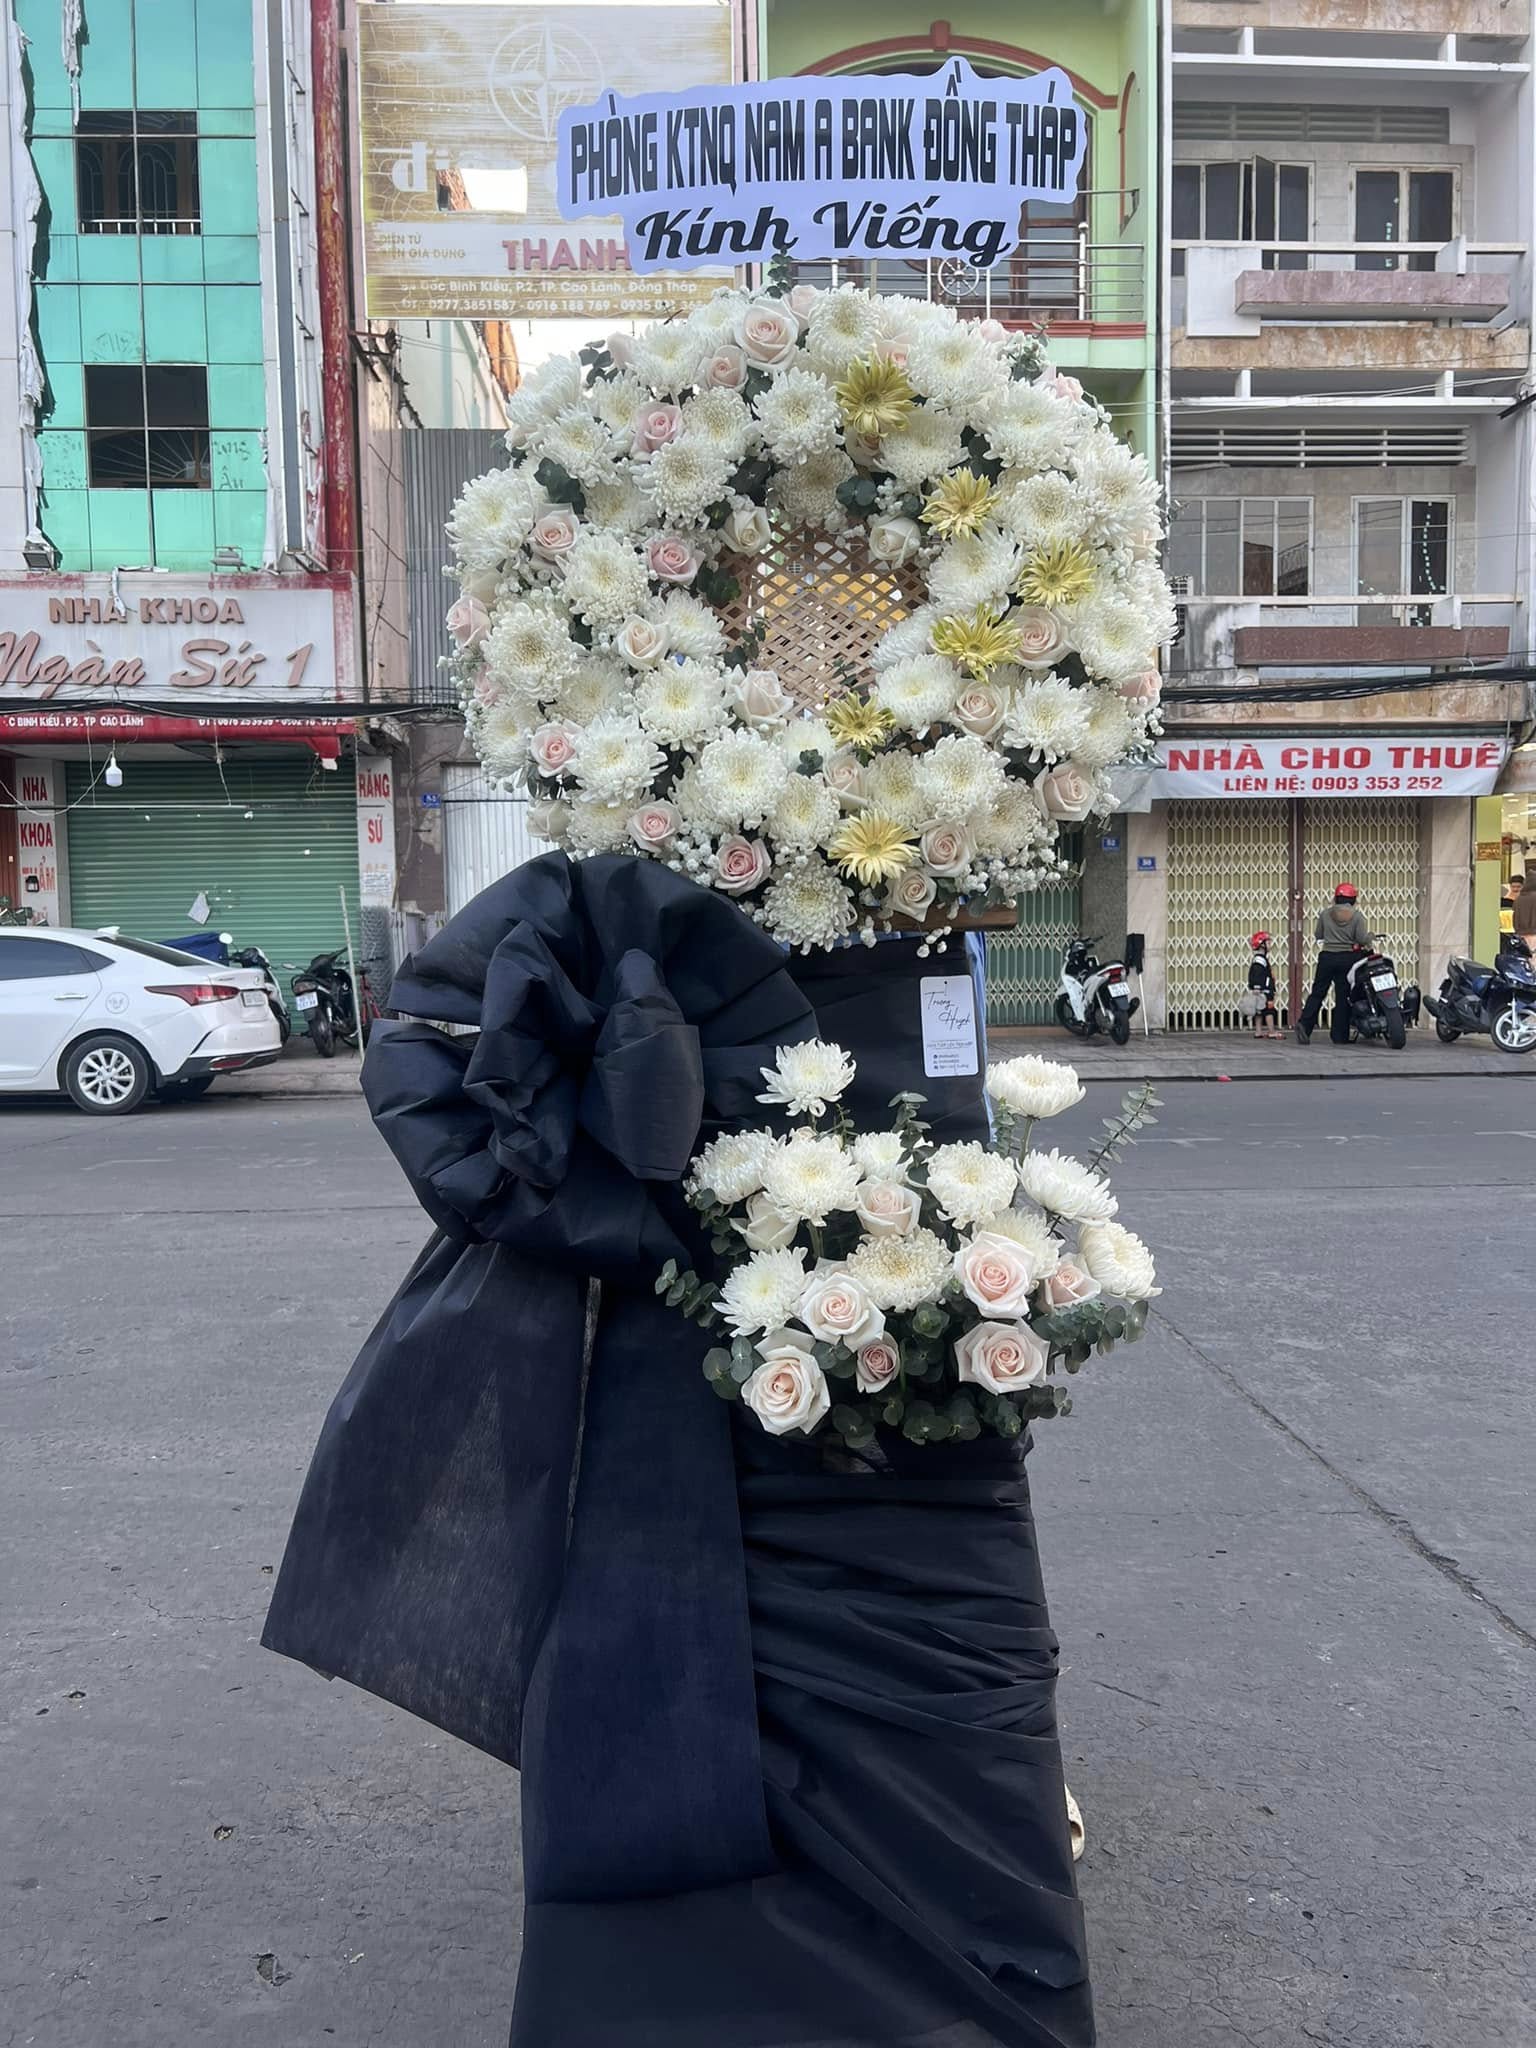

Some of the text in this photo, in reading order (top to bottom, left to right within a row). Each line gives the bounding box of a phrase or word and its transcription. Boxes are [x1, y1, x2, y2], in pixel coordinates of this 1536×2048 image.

[571, 93, 658, 204] PHÒNG
[666, 104, 738, 196] KTNQ
[744, 99, 805, 182] NAM
[814, 98, 833, 181] A
[842, 98, 915, 181] BANK
[923, 60, 997, 184] ĐỒNG
[1005, 80, 1077, 190] THÁP
[635, 195, 1012, 267] Kính Viếng
[502, 238, 632, 271] THANH
[560, 283, 588, 293] Cao
[140, 598, 245, 624] KHOA
[0, 632, 314, 699] Ngàn Sứ 1
[1167, 741, 1502, 772] NHÀ CHO THUÊ
[22, 777, 48, 801] NHA
[357, 768, 390, 798] RĂNG
[1223, 775, 1267, 792] LIÊN
[1312, 776, 1359, 792] 0903
[1364, 776, 1401, 791] 353
[1407, 776, 1443, 791] 252
[20, 823, 54, 848] KHOA
[368, 813, 384, 843] SỨ
